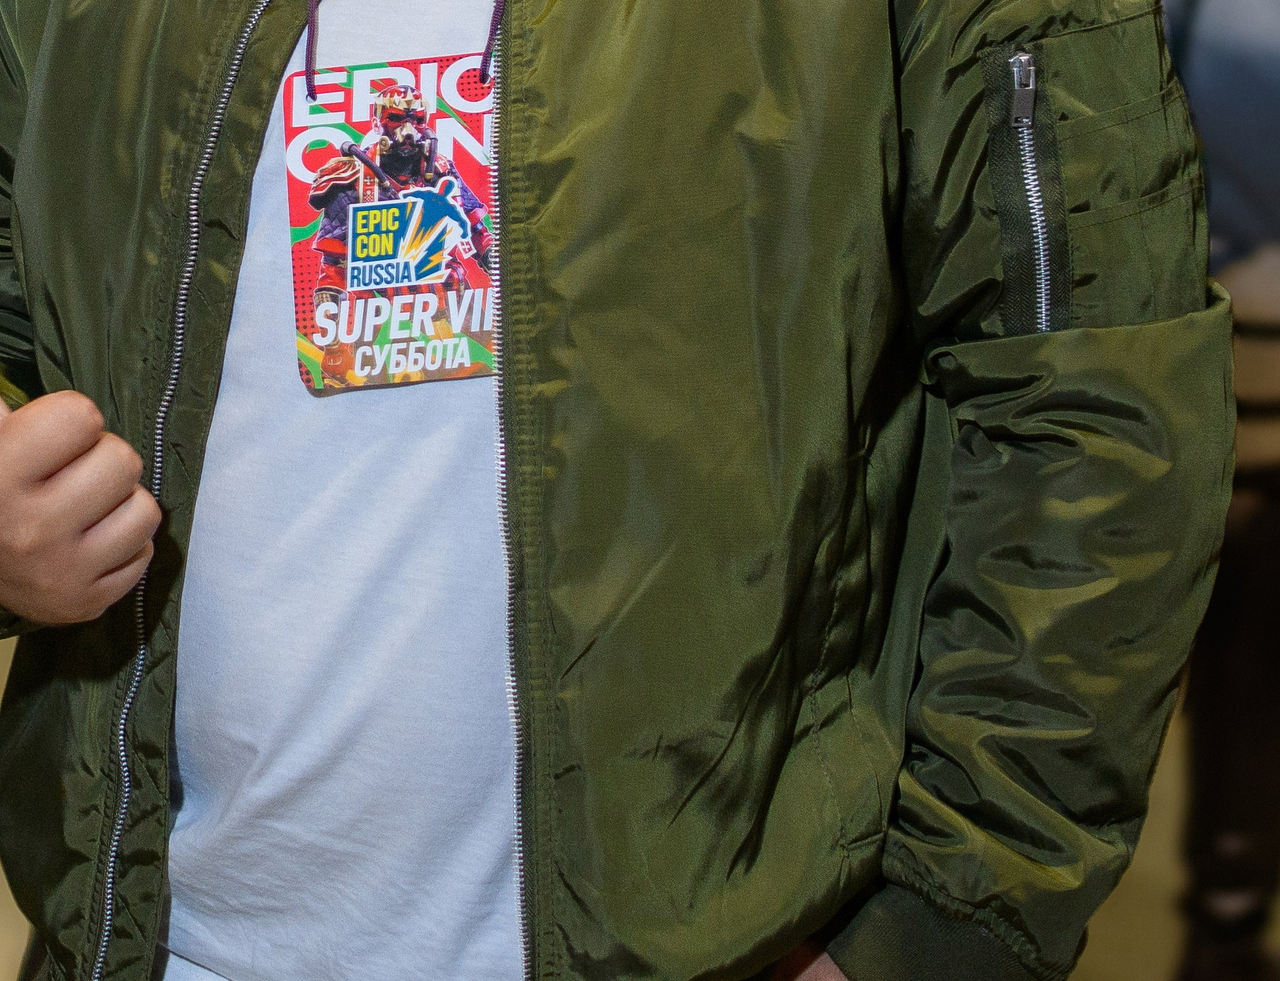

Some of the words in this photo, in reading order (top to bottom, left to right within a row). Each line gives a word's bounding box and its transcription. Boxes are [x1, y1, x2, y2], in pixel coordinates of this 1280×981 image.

[292, 55, 494, 128] EPIC
[286, 113, 493, 185] CN
[356, 207, 400, 234] EPIC
[356, 231, 394, 258] CON
[349, 260, 413, 288] RUSSIA
[313, 292, 438, 347] SUPER
[354, 337, 471, 377] СУББОТА
